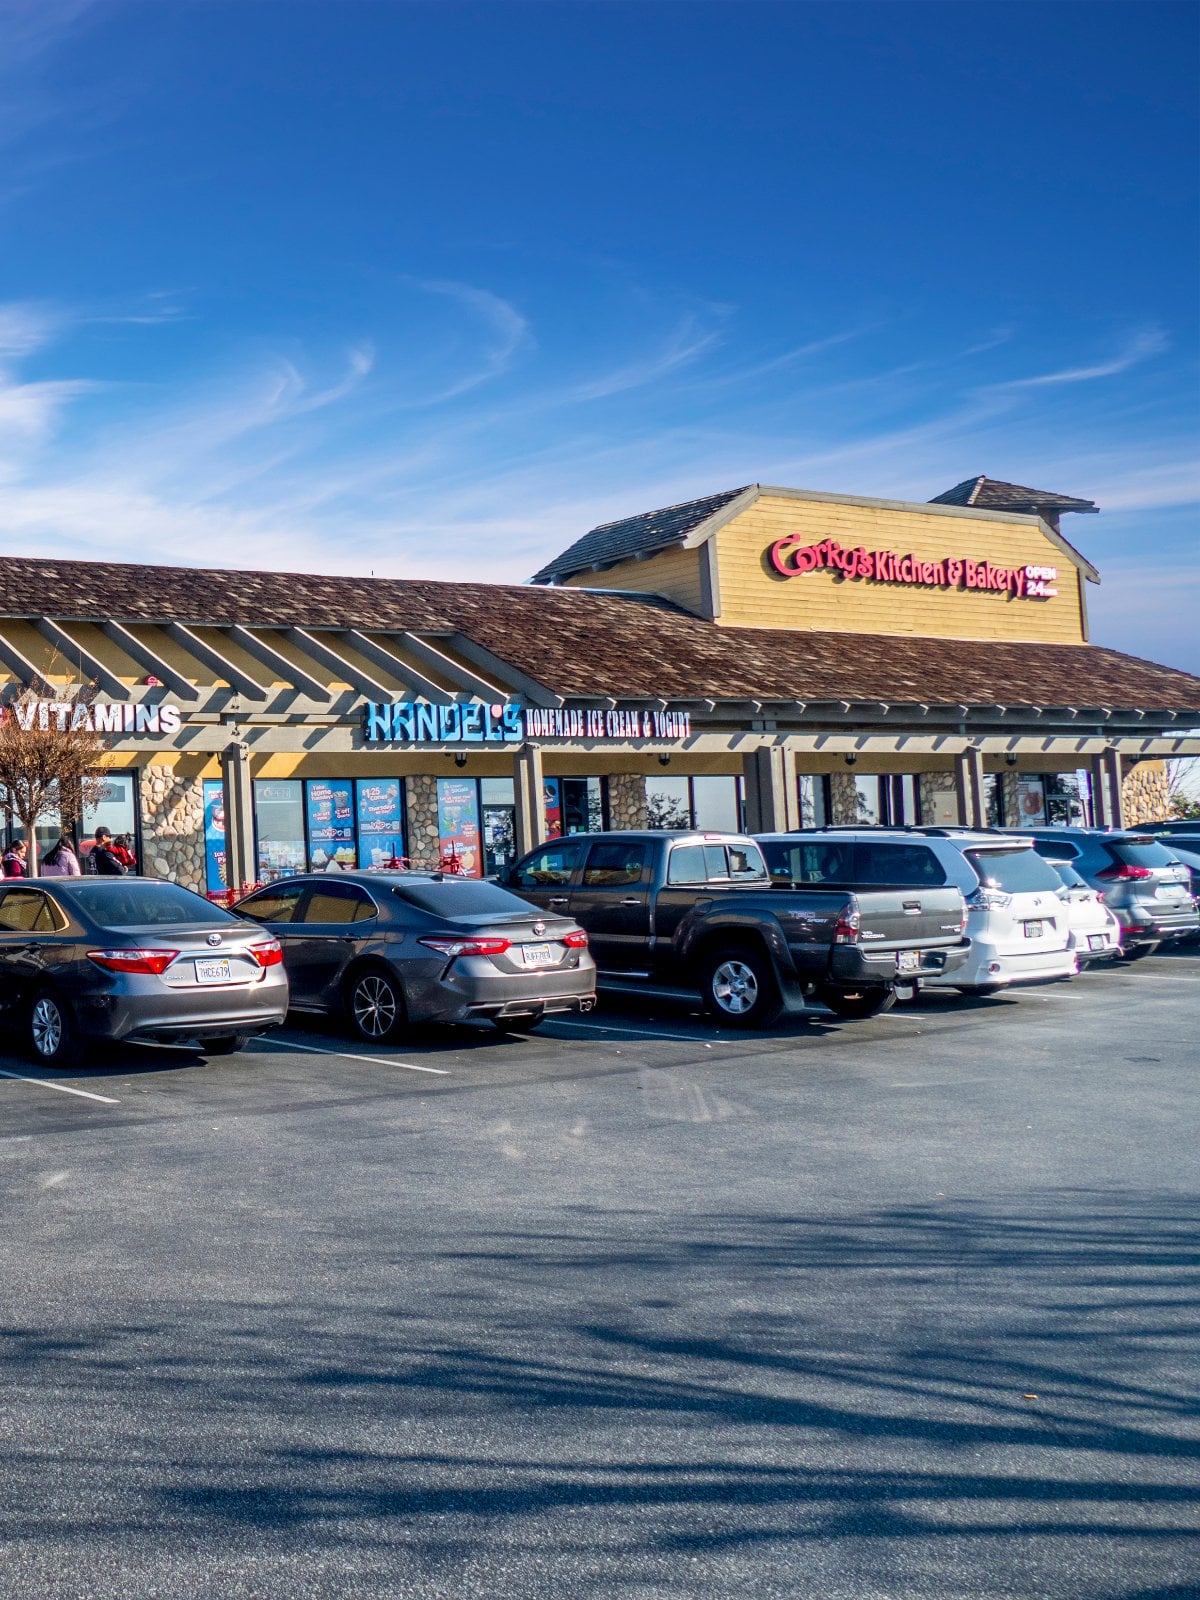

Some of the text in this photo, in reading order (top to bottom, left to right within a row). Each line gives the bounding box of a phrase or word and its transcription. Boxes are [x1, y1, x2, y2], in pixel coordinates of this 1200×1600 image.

[771, 534, 1024, 597] Corky's Kitchen & Bakery
[1026, 565, 1057, 580] OPEN
[13, 702, 182, 734] VITAMINS
[526, 708, 584, 737] HOMEMADE
[587, 709, 604, 738] ICE
[606, 710, 640, 738] CREAM
[643, 711, 650, 738] &
[653, 711, 691, 739] YOGURT
